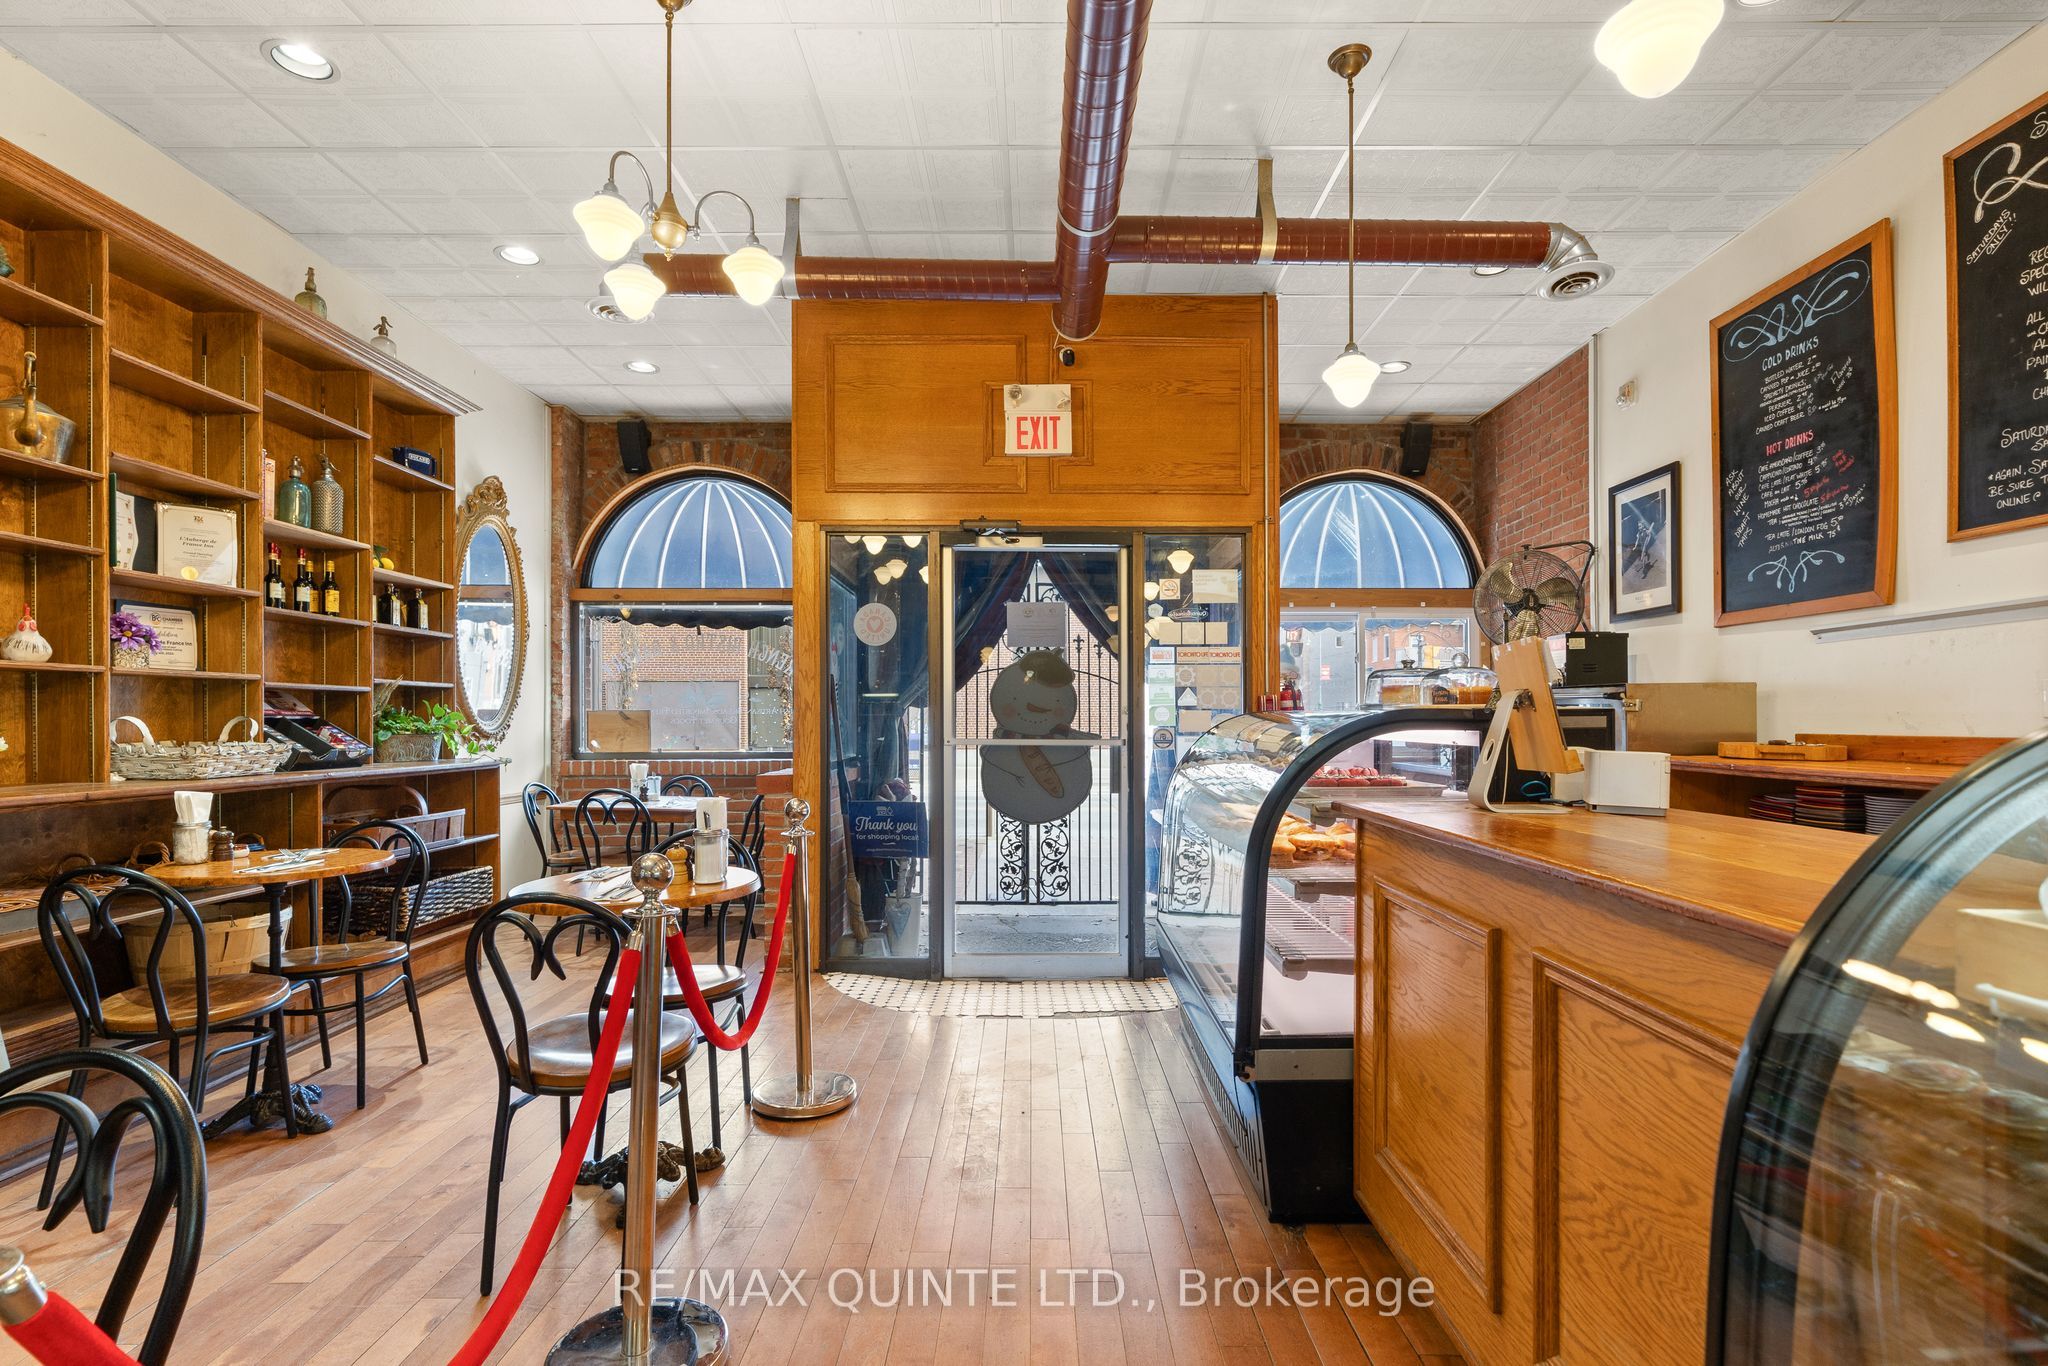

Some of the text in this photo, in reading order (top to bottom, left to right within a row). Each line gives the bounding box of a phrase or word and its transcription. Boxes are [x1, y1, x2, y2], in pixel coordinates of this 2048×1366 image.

[1966, 209, 2011, 265] SATURDAYS
[2026, 311, 2046, 326] ALL
[1762, 353, 1782, 371] COLD
[1785, 335, 1819, 361] DRINKS
[1764, 406, 1795, 422] ICED COFFEE
[1016, 415, 1061, 450] EXIT
[1766, 441, 1782, 456] HOT
[1784, 429, 1814, 449] DRINKS
[1726, 469, 1739, 487] ASK
[1728, 469, 1744, 497] ABOUT
[1734, 483, 1747, 500] OUR
[1988, 484, 2004, 497] BE
[2006, 478, 2035, 493] SURE
[1733, 492, 1750, 516] WINE
[1792, 497, 1820, 510] CHOCOLATE
[1996, 493, 2031, 510] ONLINE
[1734, 511, 1751, 538] DRAFT
[1816, 522, 1828, 531] FOG
[1737, 526, 1753, 548] TAPS
[1808, 532, 1824, 541] MILK
[855, 816, 918, 833] Thank you
[867, 833, 900, 841] shopping
